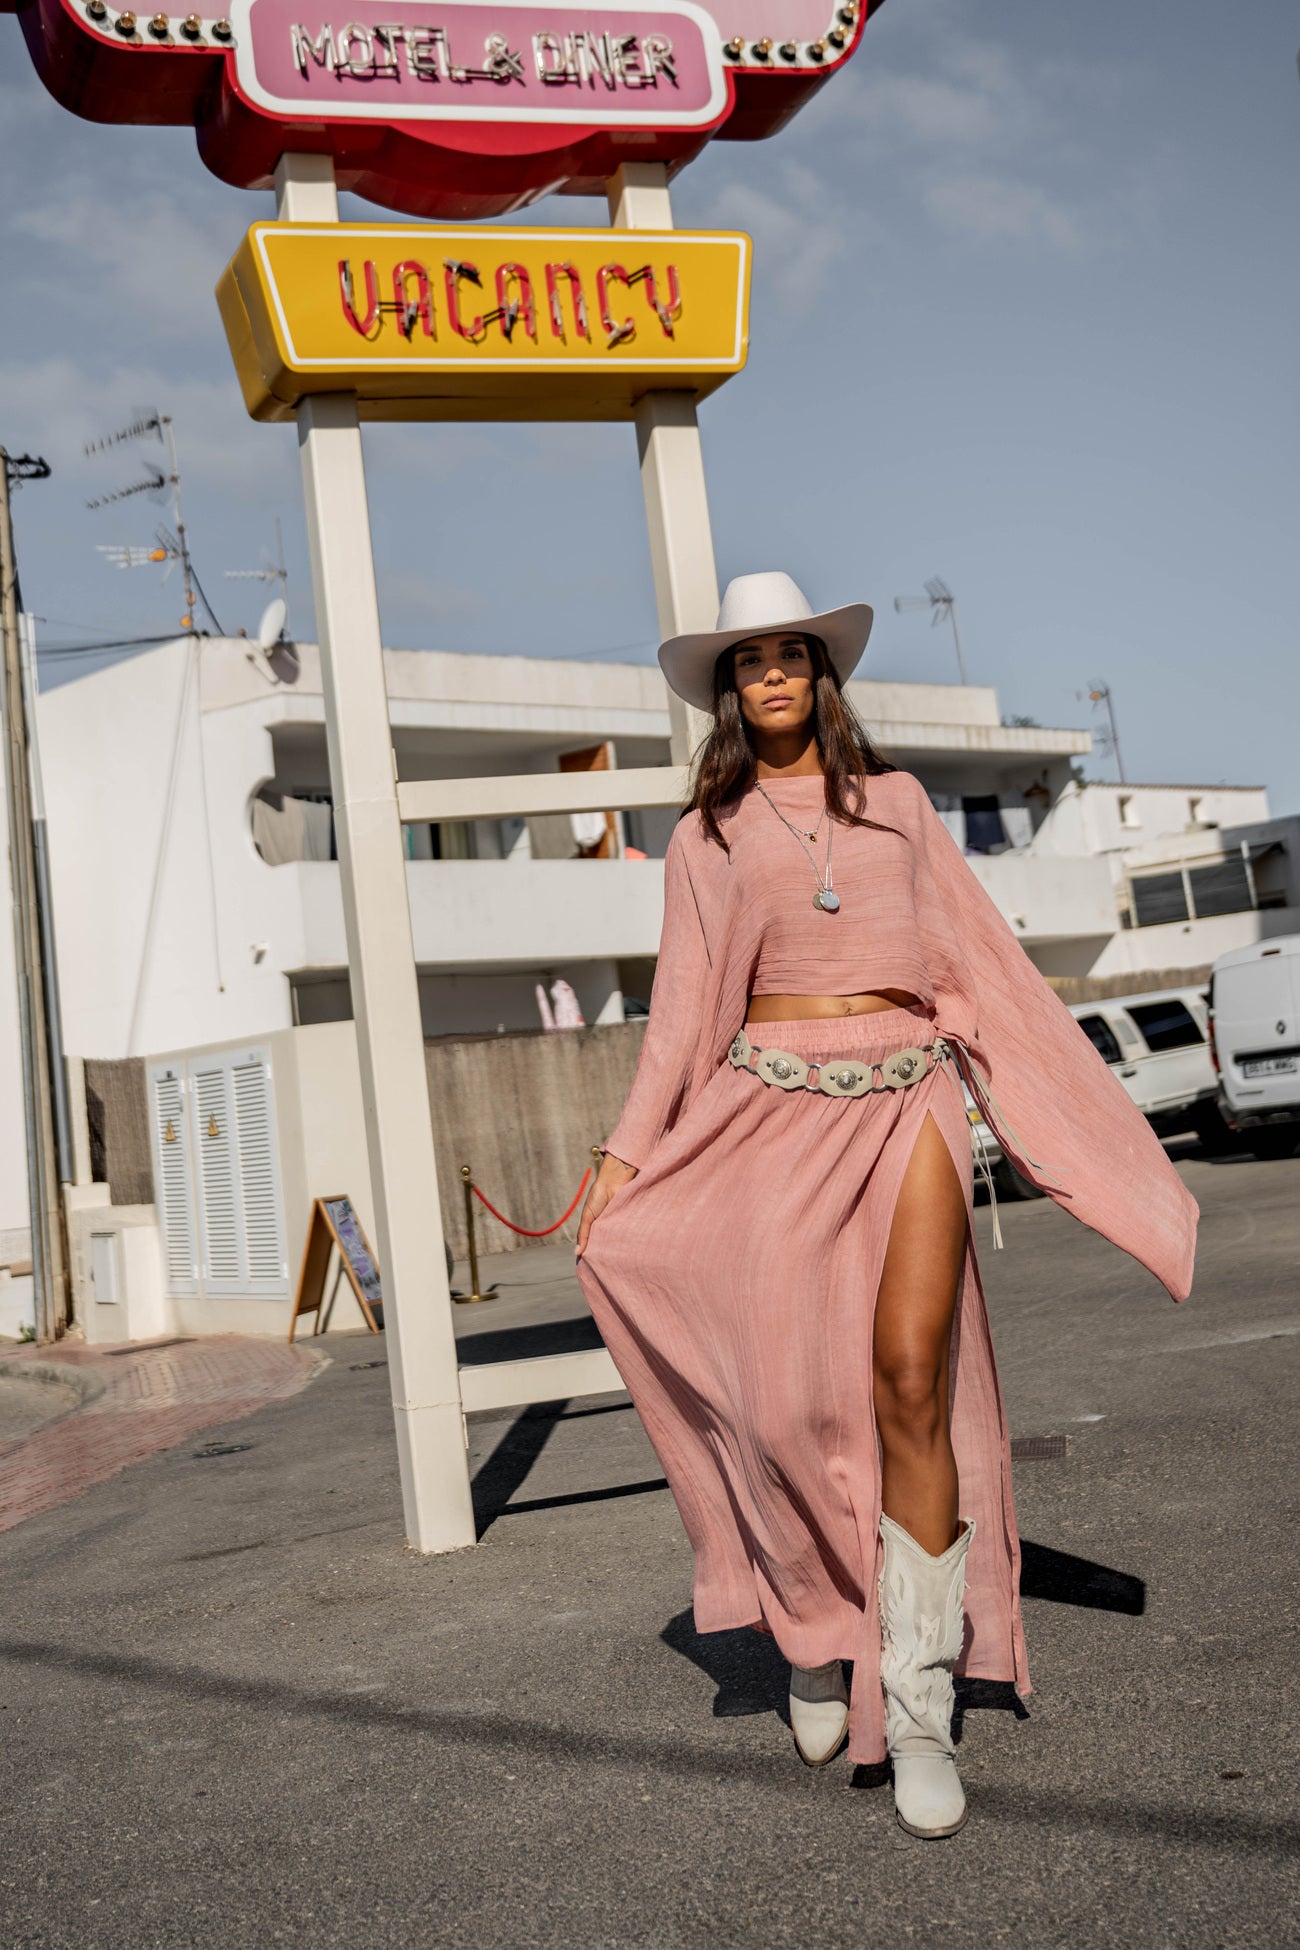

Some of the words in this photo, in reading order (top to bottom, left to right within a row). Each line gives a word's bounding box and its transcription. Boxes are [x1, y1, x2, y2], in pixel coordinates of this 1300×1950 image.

[289, 22, 471, 81] MOTEL
[483, 31, 524, 84] &
[532, 31, 680, 88] DINER
[338, 257, 682, 345] VACANCY
